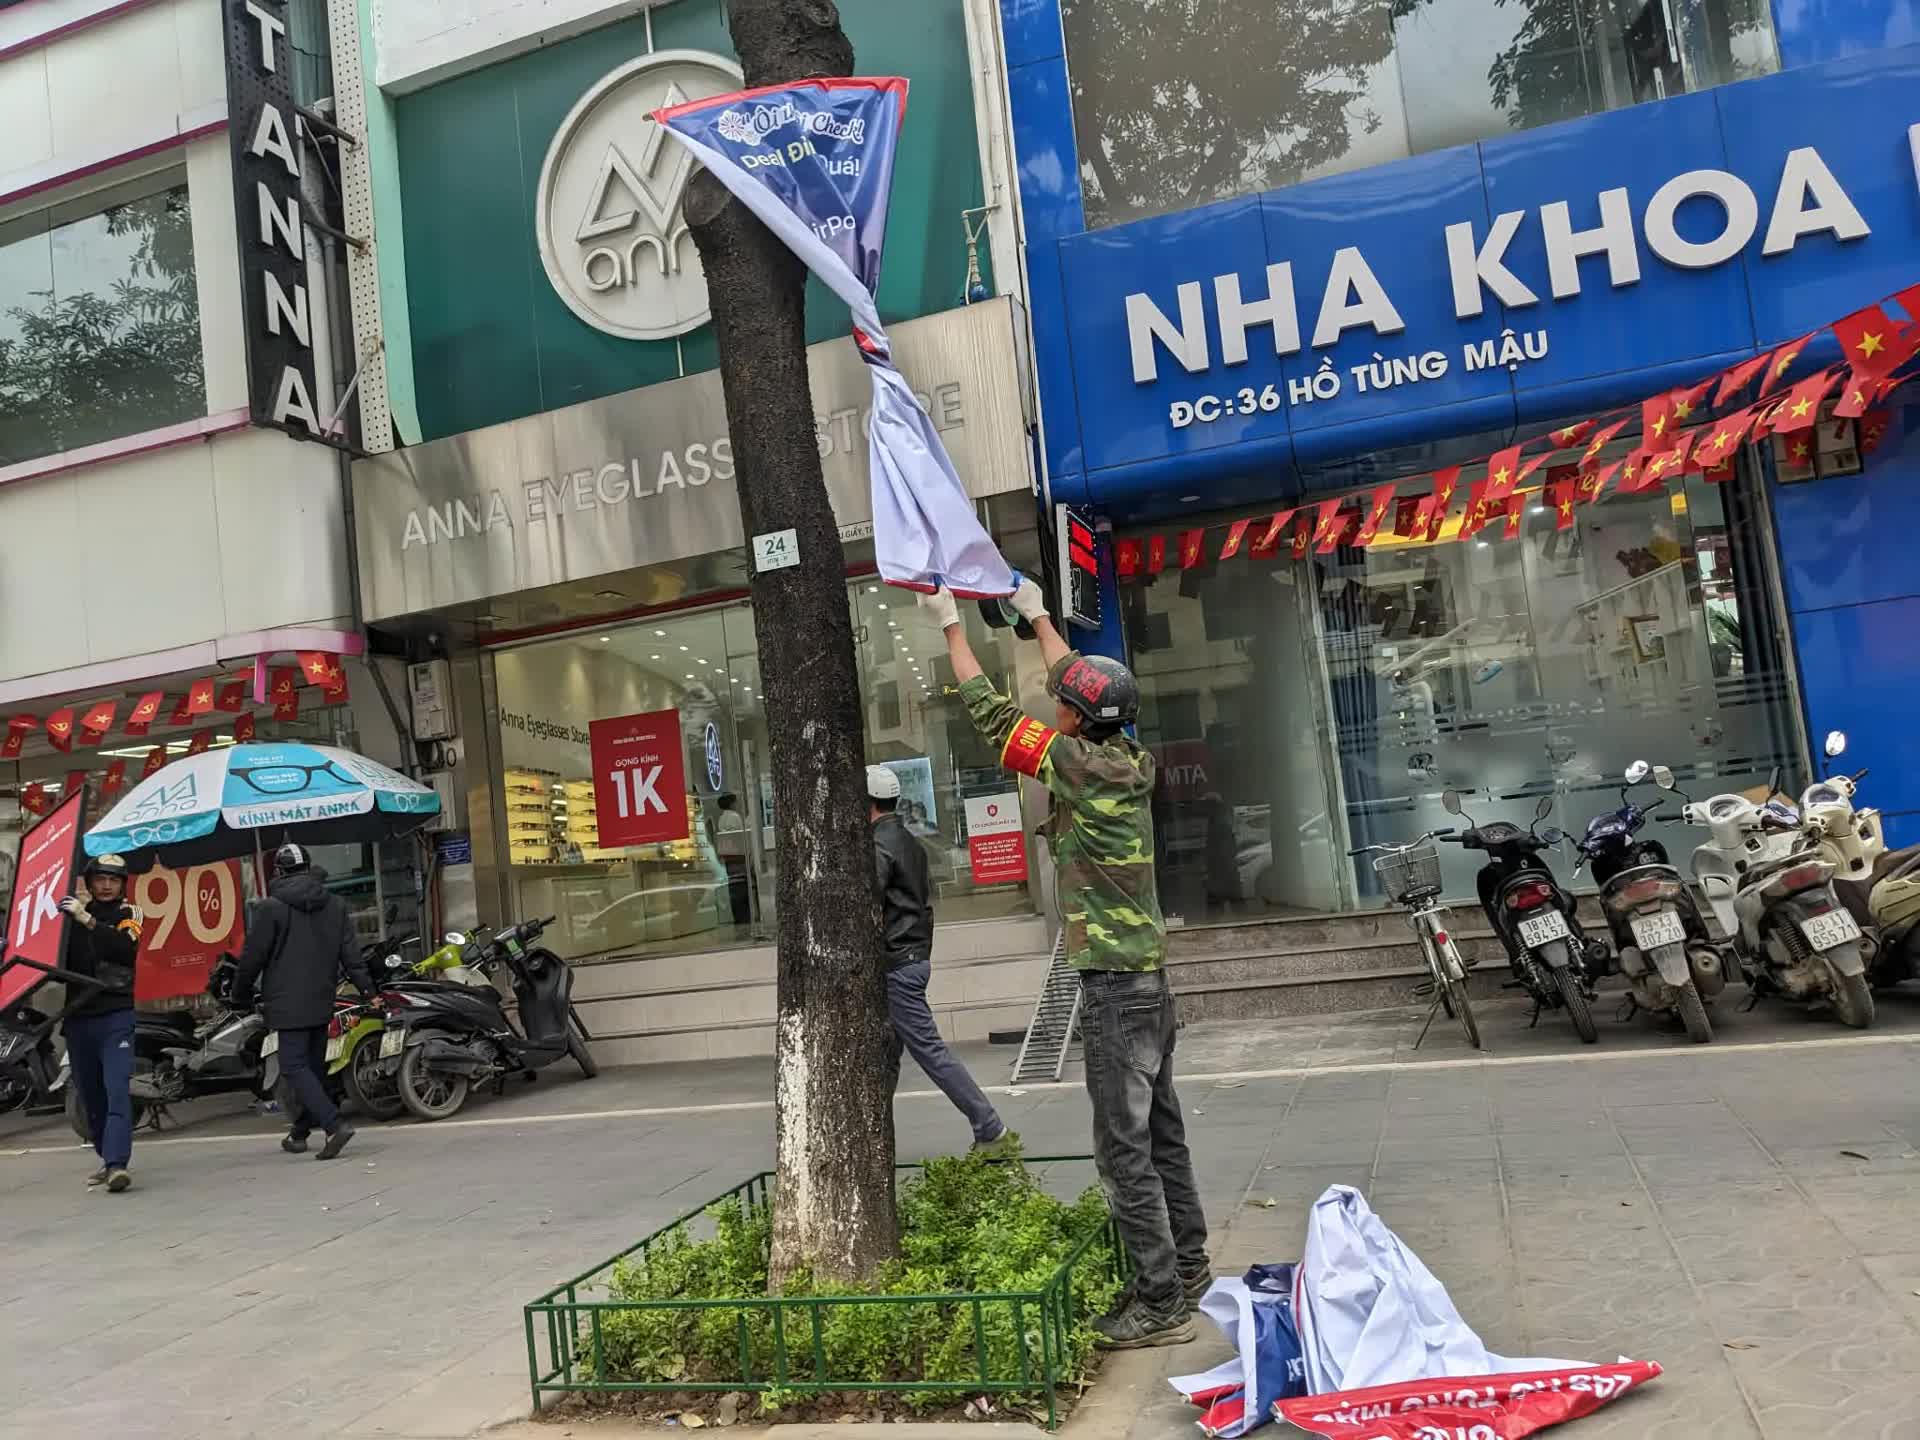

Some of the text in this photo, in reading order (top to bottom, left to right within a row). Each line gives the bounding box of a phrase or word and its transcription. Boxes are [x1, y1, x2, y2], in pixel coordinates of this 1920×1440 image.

[812, 113, 864, 144] Check!
[741, 148, 786, 169] Deal
[1124, 245, 1405, 386] NHA
[1445, 146, 1872, 320] KHOA
[1169, 328, 1549, 428] ĐC:36 HỒ TÙNG MẬU
[401, 488, 514, 550] ANNA
[814, 381, 966, 459] STE
[764, 536, 786, 556] 24
[501, 709, 525, 731] Anna
[527, 714, 570, 740] Eyeglasses
[572, 728, 589, 745] Store
[238, 809, 276, 827] KÍNH
[318, 801, 360, 817] ANNA
[610, 765, 669, 819] 1K
[16, 866, 66, 949] 1K
